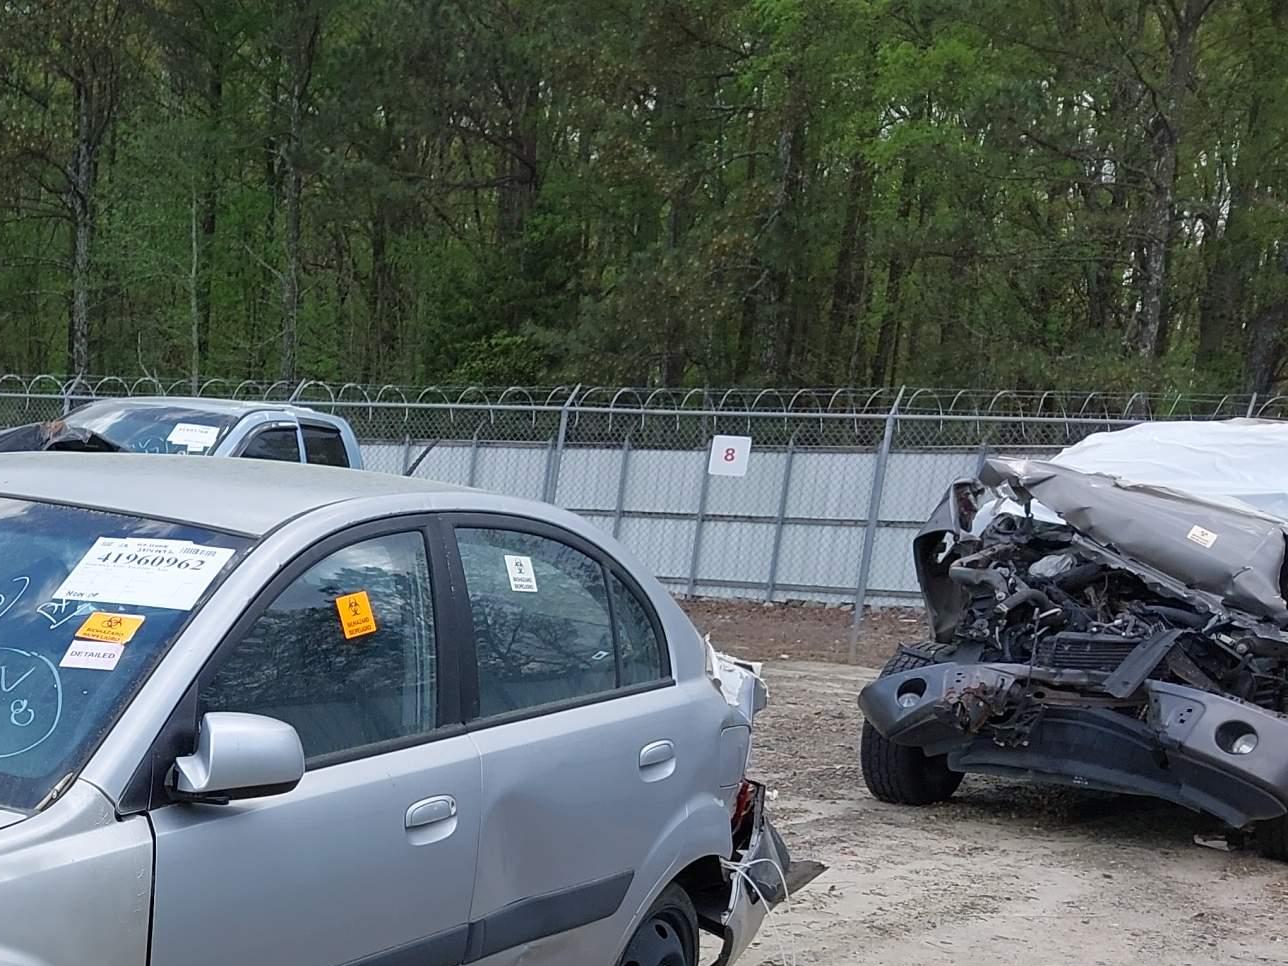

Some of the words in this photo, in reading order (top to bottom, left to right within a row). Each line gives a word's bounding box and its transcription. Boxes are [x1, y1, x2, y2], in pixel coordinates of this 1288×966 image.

[724, 447, 735, 462] 8
[97, 551, 205, 571] 41960962
[70, 650, 116, 659] DETAILED
